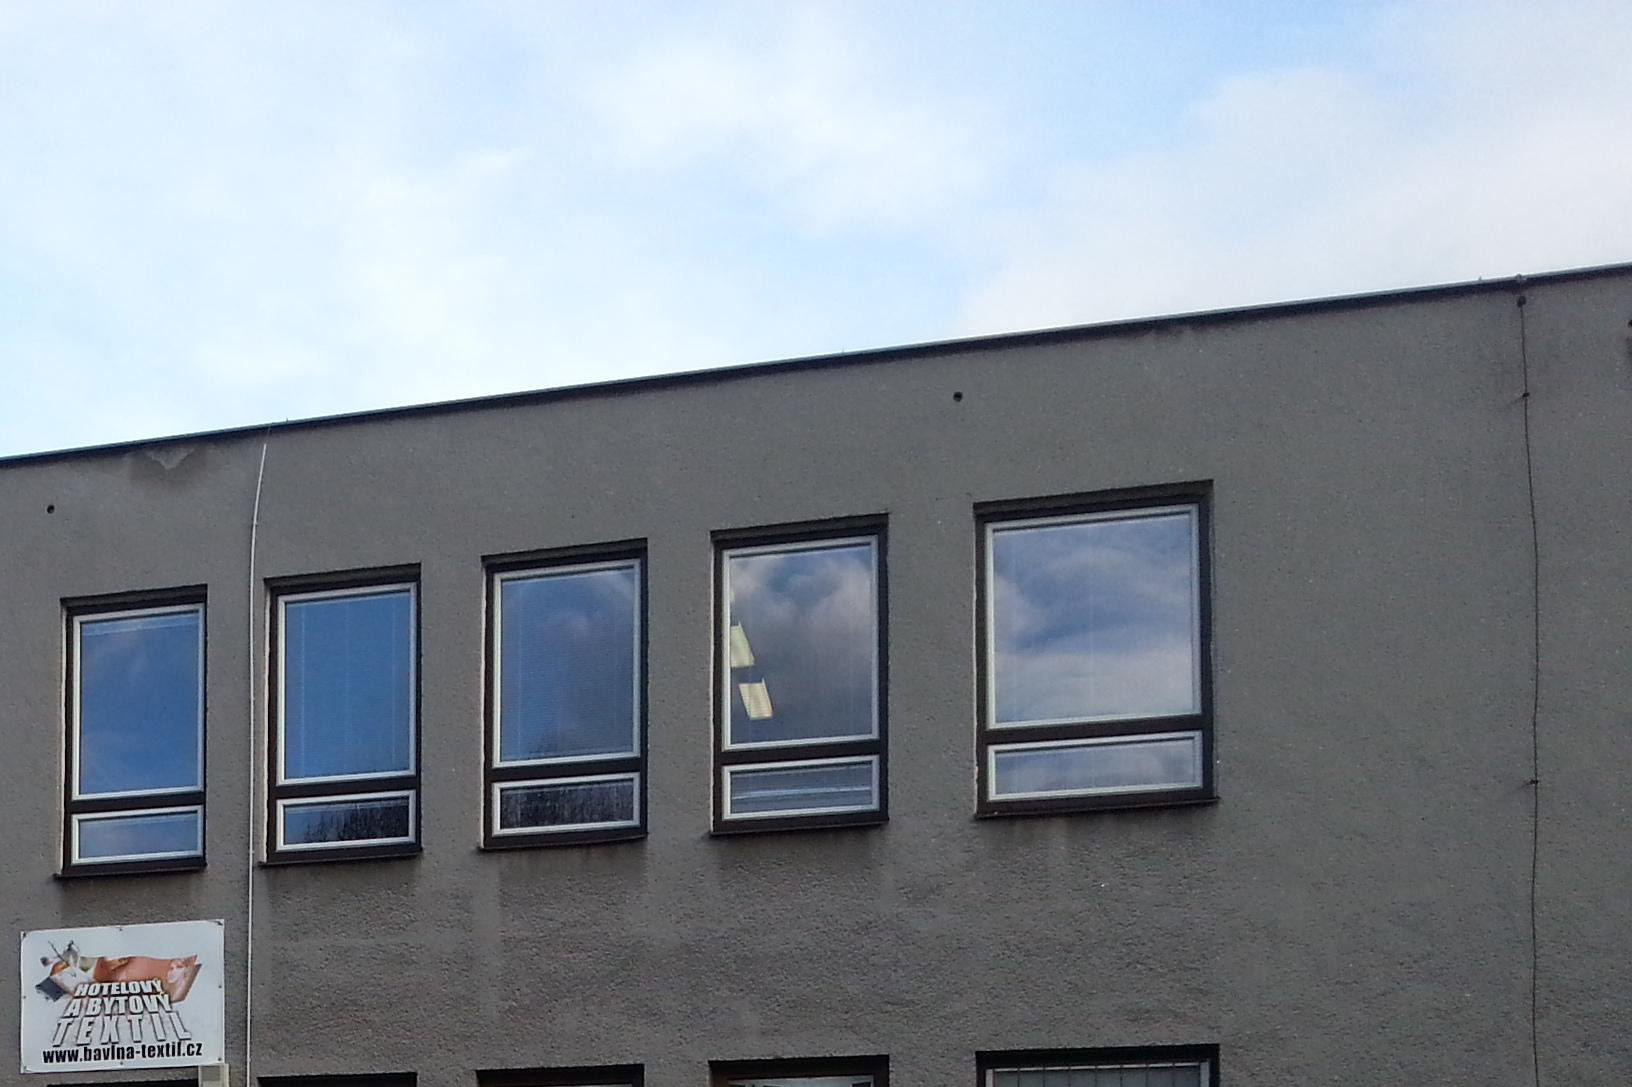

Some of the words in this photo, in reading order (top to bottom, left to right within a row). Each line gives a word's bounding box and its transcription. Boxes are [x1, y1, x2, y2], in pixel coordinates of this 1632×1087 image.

[74, 978, 164, 997] HOTELOVÝ
[63, 998, 82, 1018] A
[85, 993, 173, 1017] BYTOVÝ
[52, 1012, 193, 1047] TEXTIL
[42, 1042, 203, 1064] www.bavlna-textil.cz
